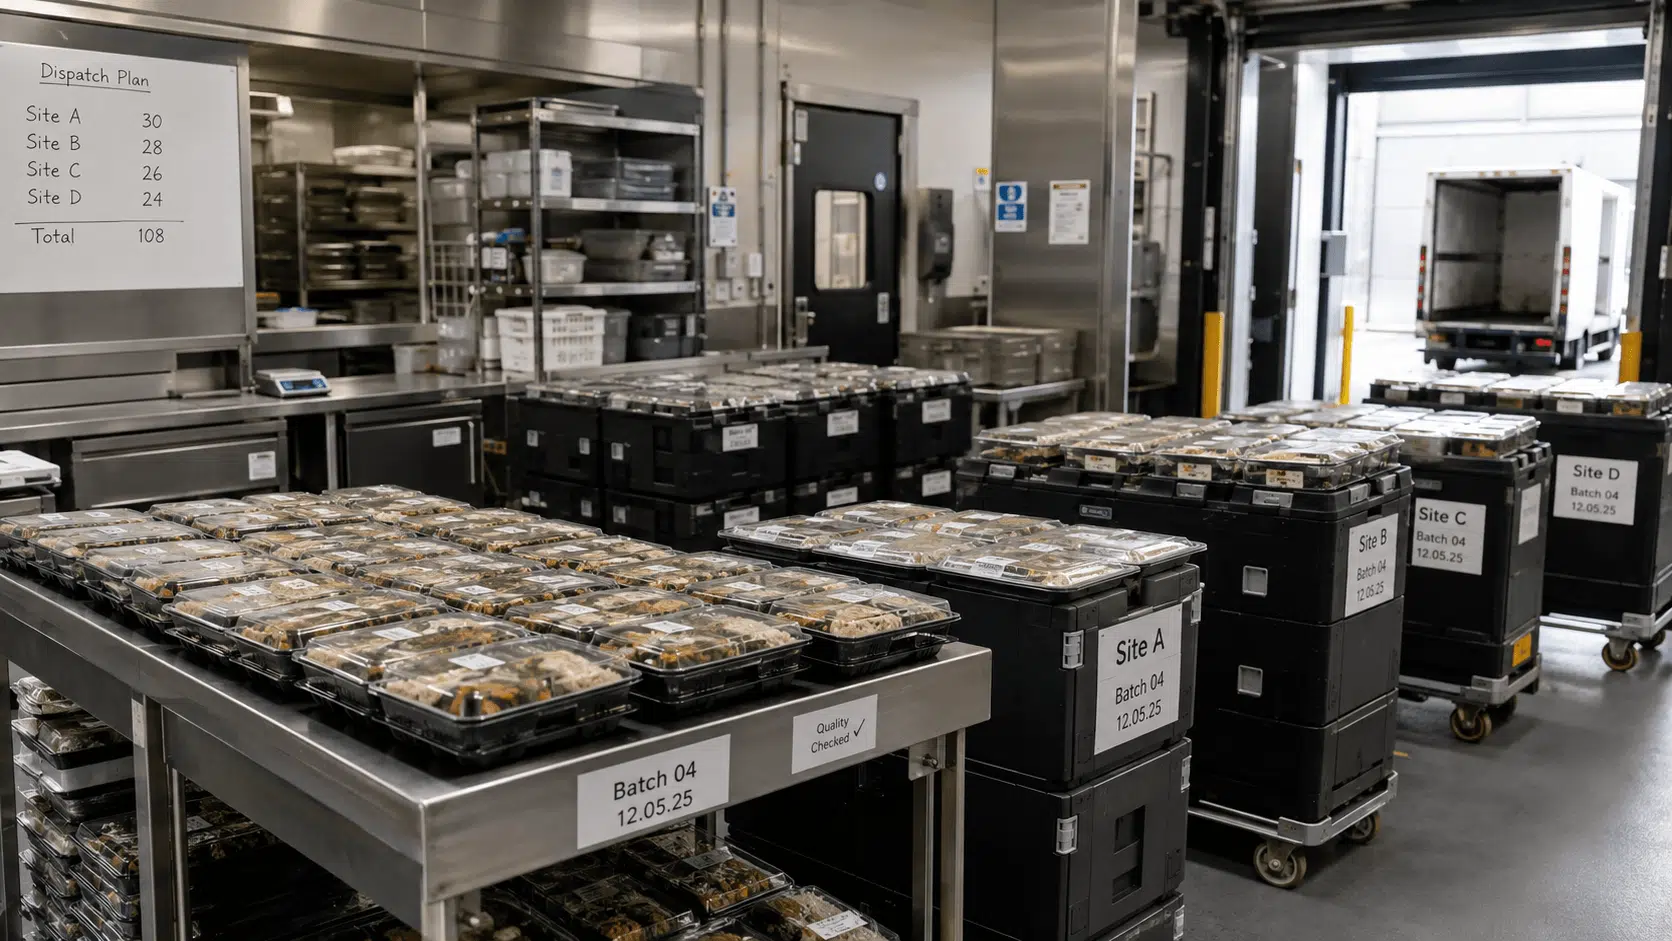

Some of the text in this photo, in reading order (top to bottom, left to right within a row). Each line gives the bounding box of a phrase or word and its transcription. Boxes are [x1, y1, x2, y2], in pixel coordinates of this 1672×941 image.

[40, 62, 150, 87] Dispatch Plan
[26, 104, 163, 129] Site A 30
[26, 133, 163, 155] Site B 28
[26, 160, 163, 181] Site C 26
[27, 188, 163, 207] Site D 24
[31, 227, 165, 244] Total 108
[1572, 464, 1620, 481] Site D
[1570, 486, 1619, 500] Batch 04
[1418, 506, 1467, 525] Site C
[1571, 501, 1617, 515] 12.05.25
[1359, 528, 1386, 552] Site B
[1416, 530, 1466, 547] Batch 04
[1416, 547, 1464, 564] 12.05.25
[1357, 559, 1386, 581] Batch 04
[1116, 627, 1165, 666] Site A
[1115, 670, 1165, 706] Batch 04
[816, 716, 850, 735] Quality
[1116, 699, 1162, 732] 12.05.25
[810, 732, 850, 754] Checked
[613, 760, 698, 801] Batch 04
[617, 788, 694, 827] 12.05.25
